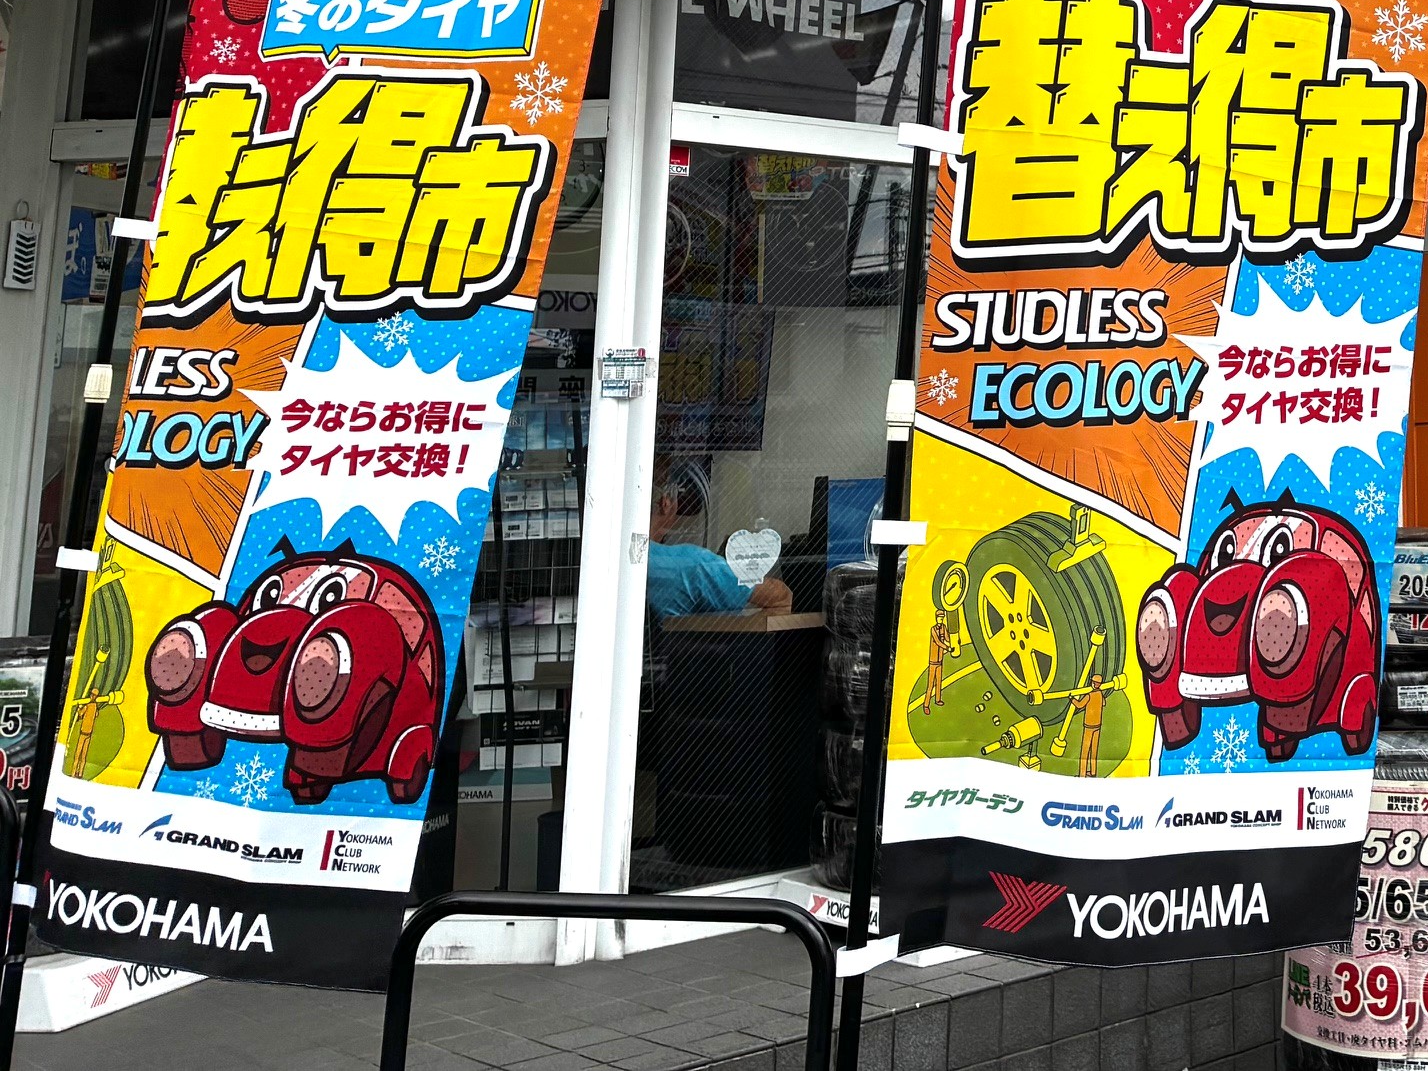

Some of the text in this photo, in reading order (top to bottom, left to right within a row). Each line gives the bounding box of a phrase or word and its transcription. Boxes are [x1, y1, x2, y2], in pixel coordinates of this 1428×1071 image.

[931, 288, 1169, 352] STUDLESS
[130, 347, 237, 399] LESS
[1218, 344, 1391, 380] 今ならお得に
[970, 359, 1204, 426] ECOLOGY
[280, 400, 486, 435] 今ならお得に
[117, 410, 266, 464] LOGY
[905, 787, 1024, 813] タイヤガーデン
[1307, 786, 1353, 800] YOKOHAMA
[1173, 809, 1282, 827] GRAND SLAM
[1307, 802, 1330, 815] CLUB
[338, 830, 393, 846] YOKOHAMA
[1306, 817, 1347, 830] NETWORK
[166, 830, 240, 853] GRAND
[241, 843, 304, 862] SLAM
[335, 845, 362, 858] CLUB
[331, 859, 381, 875] NETWORK
[45, 882, 273, 953] YOKOHAMA
[1066, 882, 1269, 939] YOKOHAMA
[123, 963, 178, 990] YOKO
